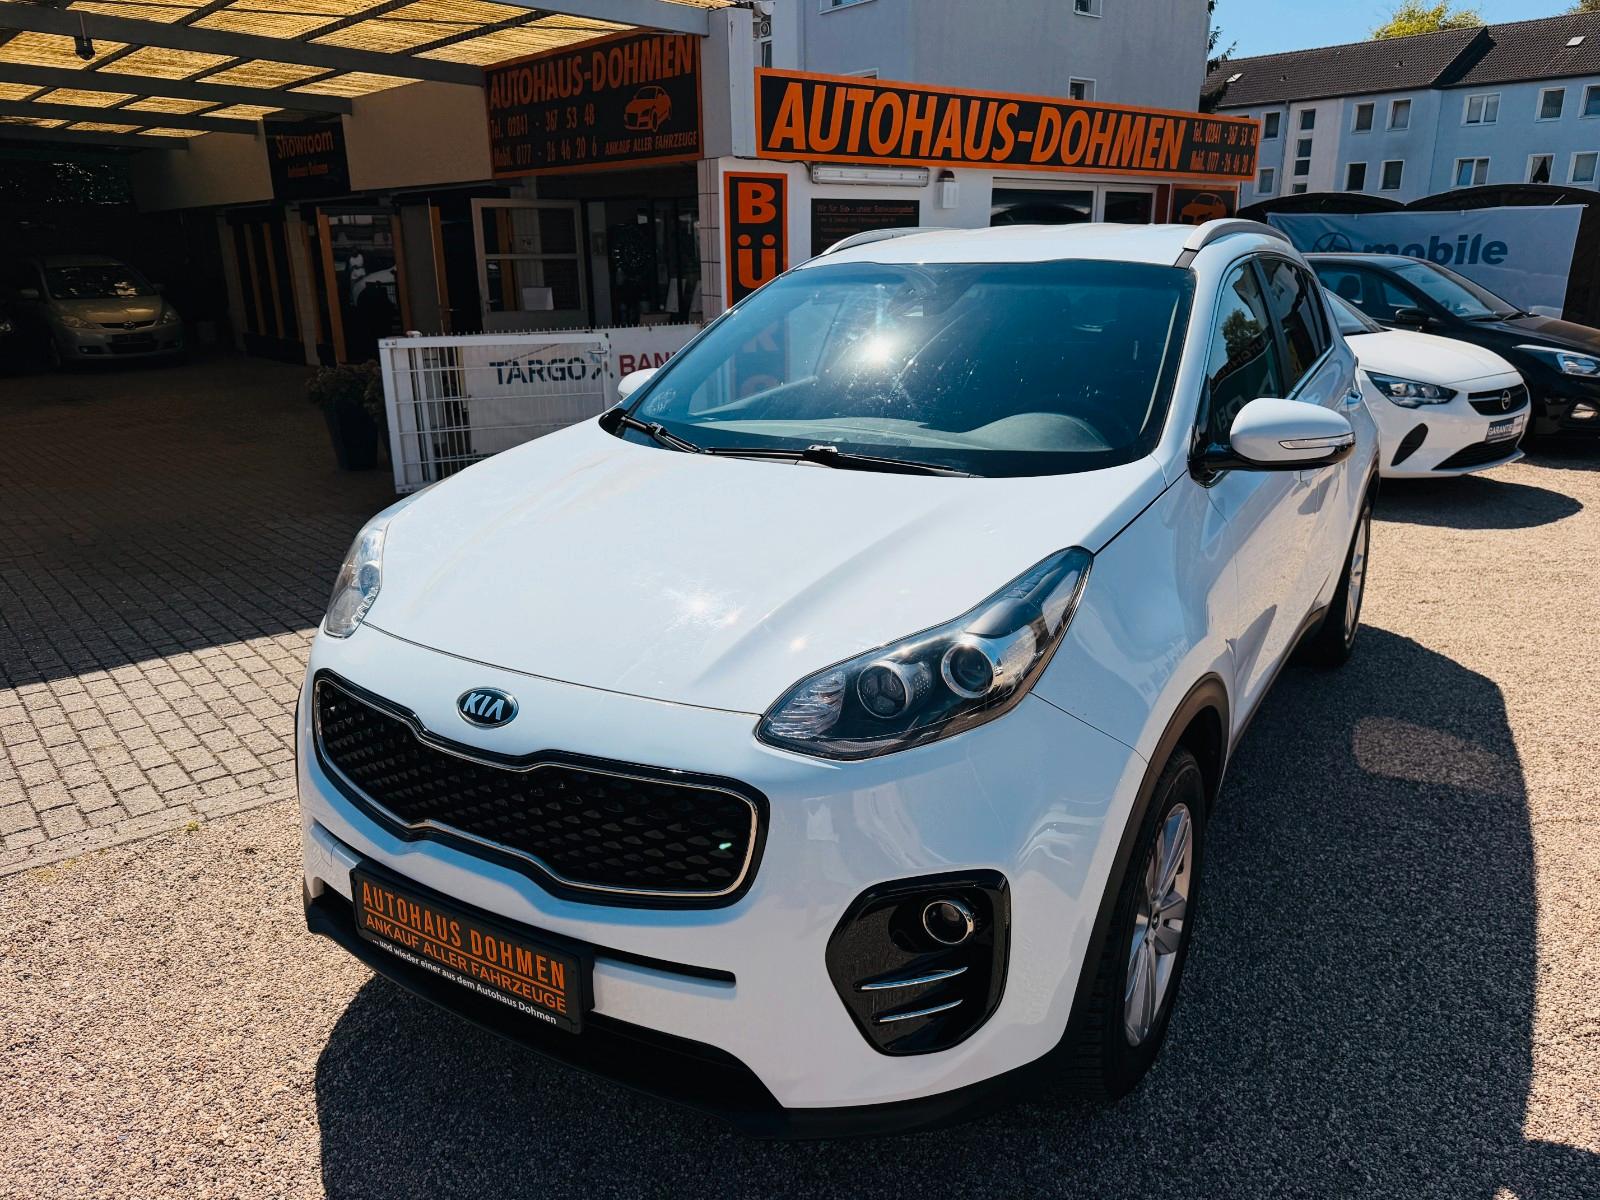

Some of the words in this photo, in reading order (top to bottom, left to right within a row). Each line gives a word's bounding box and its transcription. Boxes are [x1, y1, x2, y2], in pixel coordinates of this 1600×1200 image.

[489, 35, 693, 110] AUTOHAUS-DOHMEN
[565, 105, 578, 129] 53
[767, 82, 1187, 170] AUTOHAUS-DOHMEN
[275, 131, 334, 159] Showroom
[605, 139, 631, 155] ANKAUF
[632, 136, 653, 152] ALLER
[655, 131, 697, 150] FAHRZEUGE
[1363, 233, 1508, 266] mobile
[489, 356, 586, 385] TARGO
[619, 351, 677, 377] BAN
[463, 692, 505, 721] KIA
[362, 880, 462, 947] AUTOHAUS
[470, 928, 565, 990] DOHMEN
[366, 913, 419, 949] ANKAUF
[423, 941, 468, 973] ALLER
[471, 961, 567, 1015] FAHRZEUGE
[379, 940, 393, 952] und
[393, 948, 420, 965] wieder
[420, 959, 441, 974] einer
[441, 970, 456, 981] aus
[457, 976, 475, 990] dem
[476, 983, 517, 1008] Autohaus
[518, 1001, 557, 1025] Dohmen
